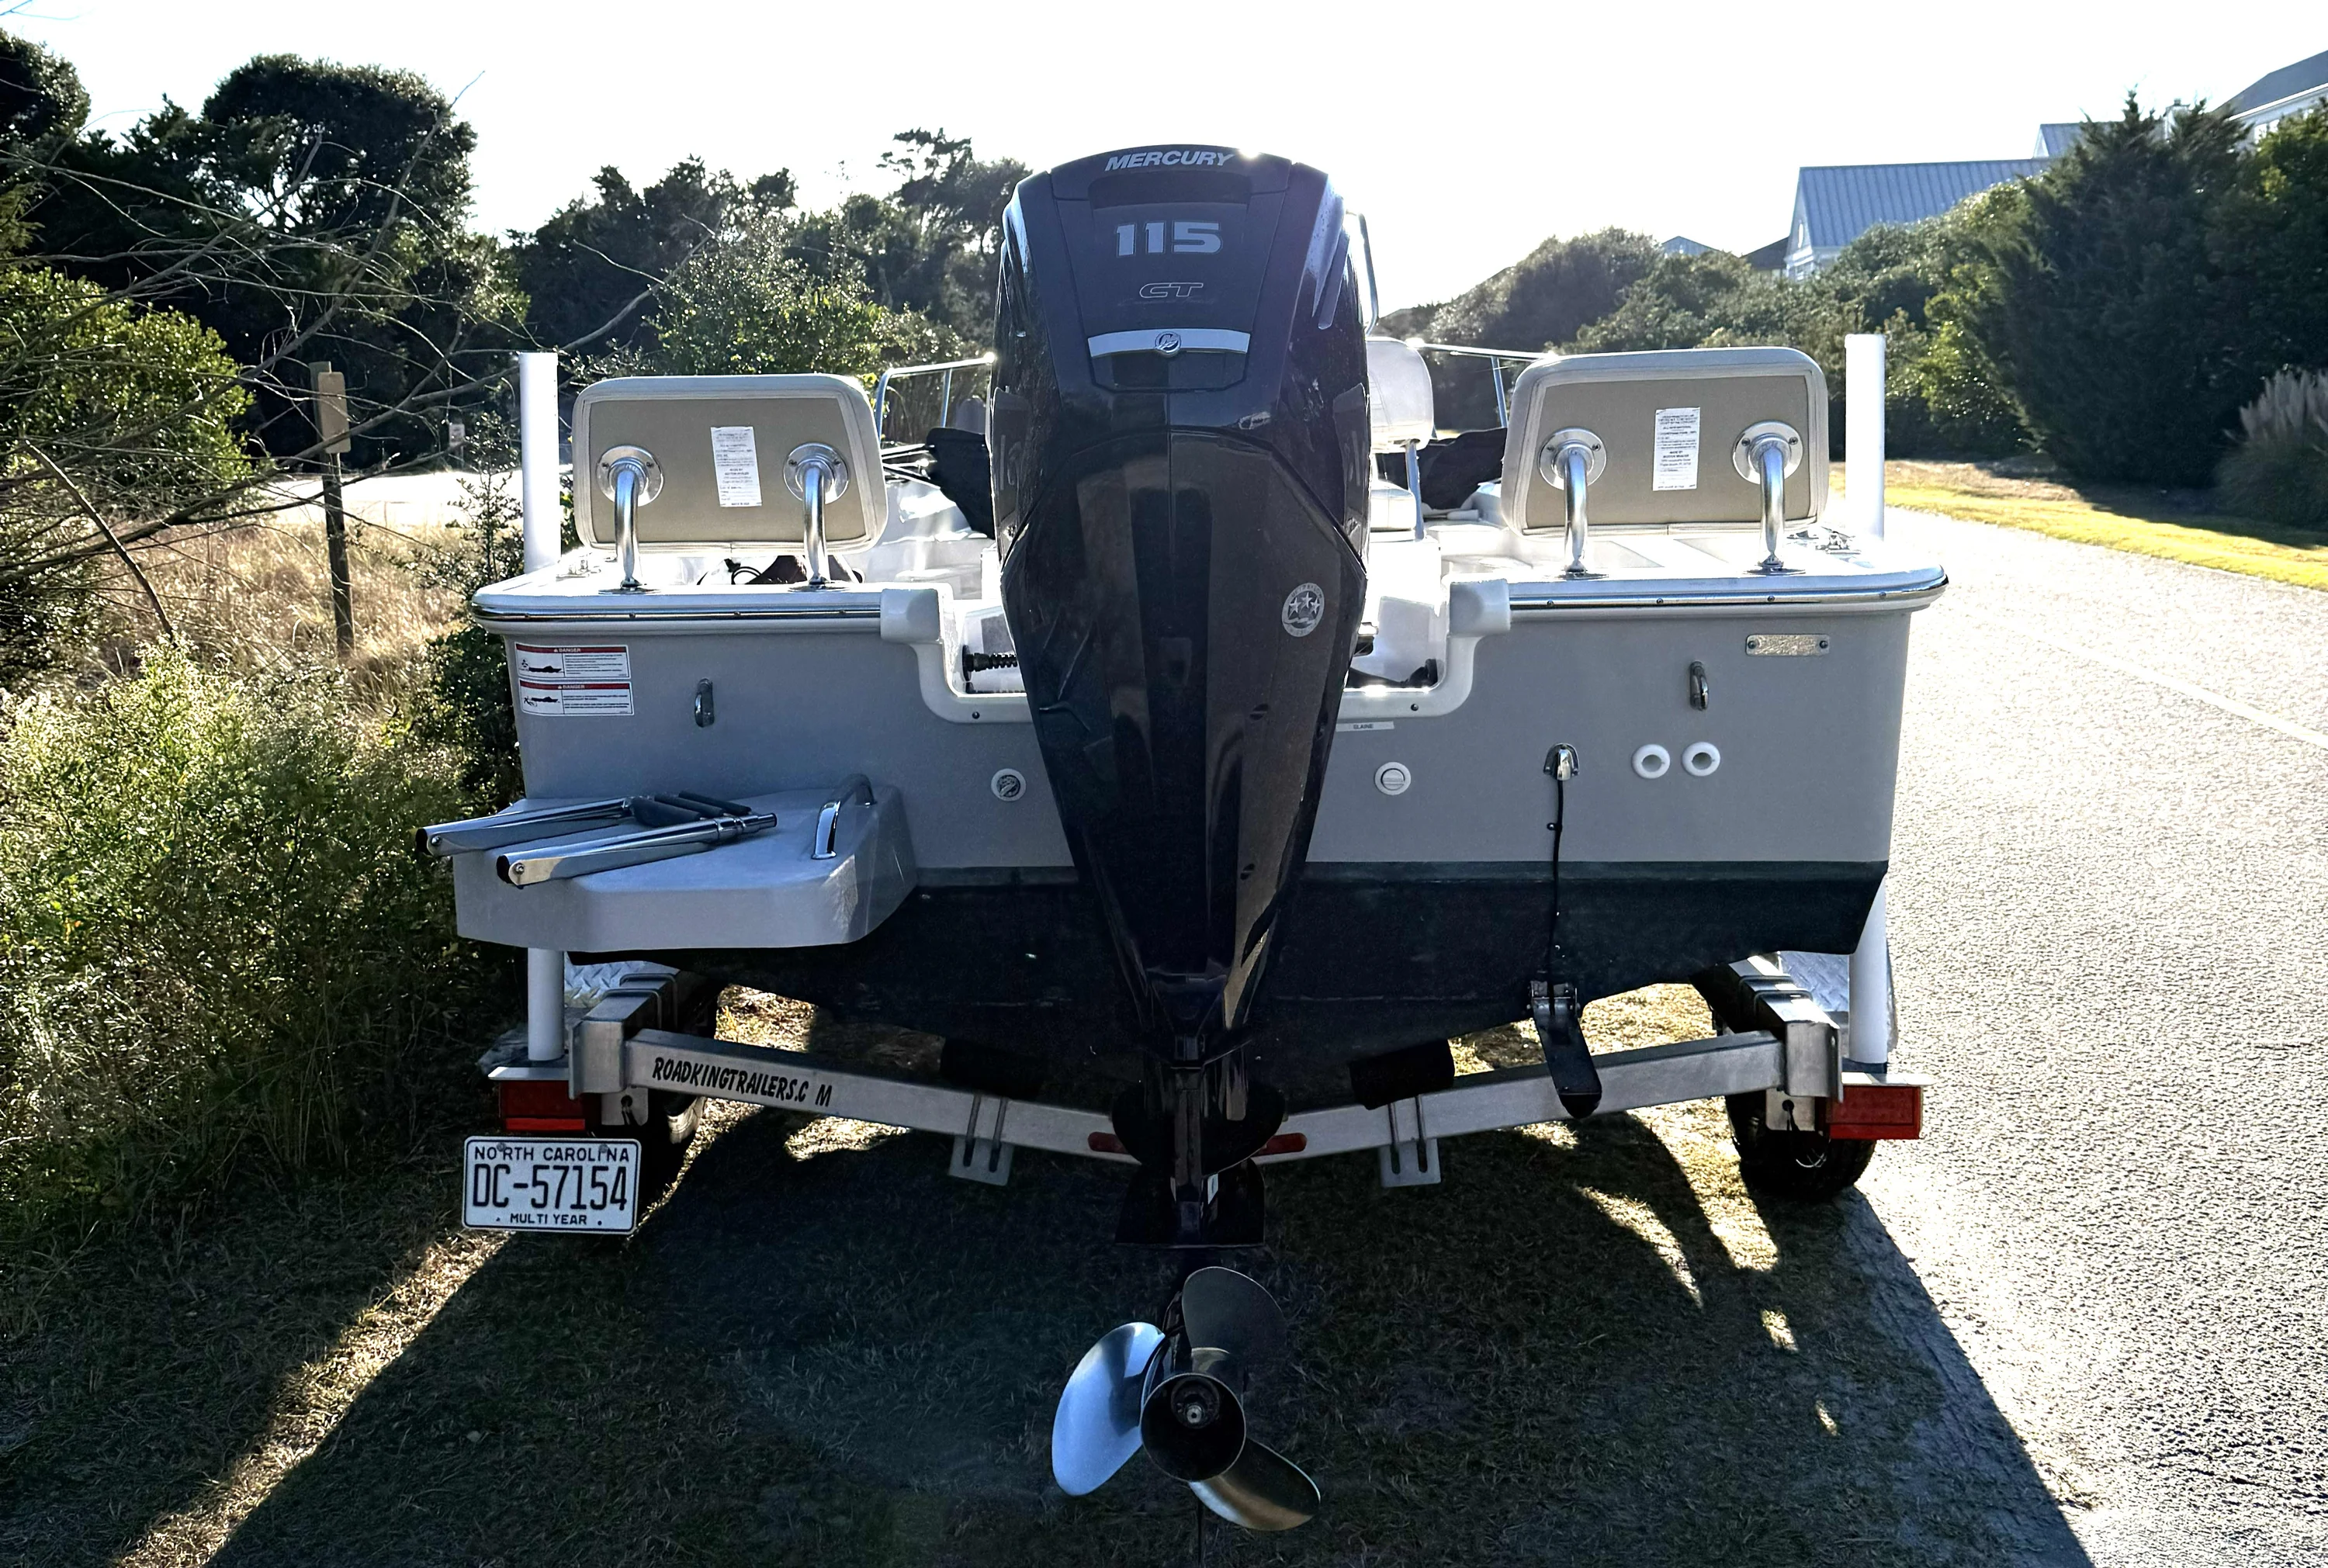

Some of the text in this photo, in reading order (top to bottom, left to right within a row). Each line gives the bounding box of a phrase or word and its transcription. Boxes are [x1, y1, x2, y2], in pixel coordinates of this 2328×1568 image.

[1104, 150, 1235, 171] MERCURY
[1115, 220, 1223, 258] 115
[1139, 282, 1204, 299] CT
[474, 1146, 630, 1162] NORTH CAROLINA
[473, 1163, 627, 1211] DC-57154
[510, 1213, 587, 1226] MULTI YEAR
